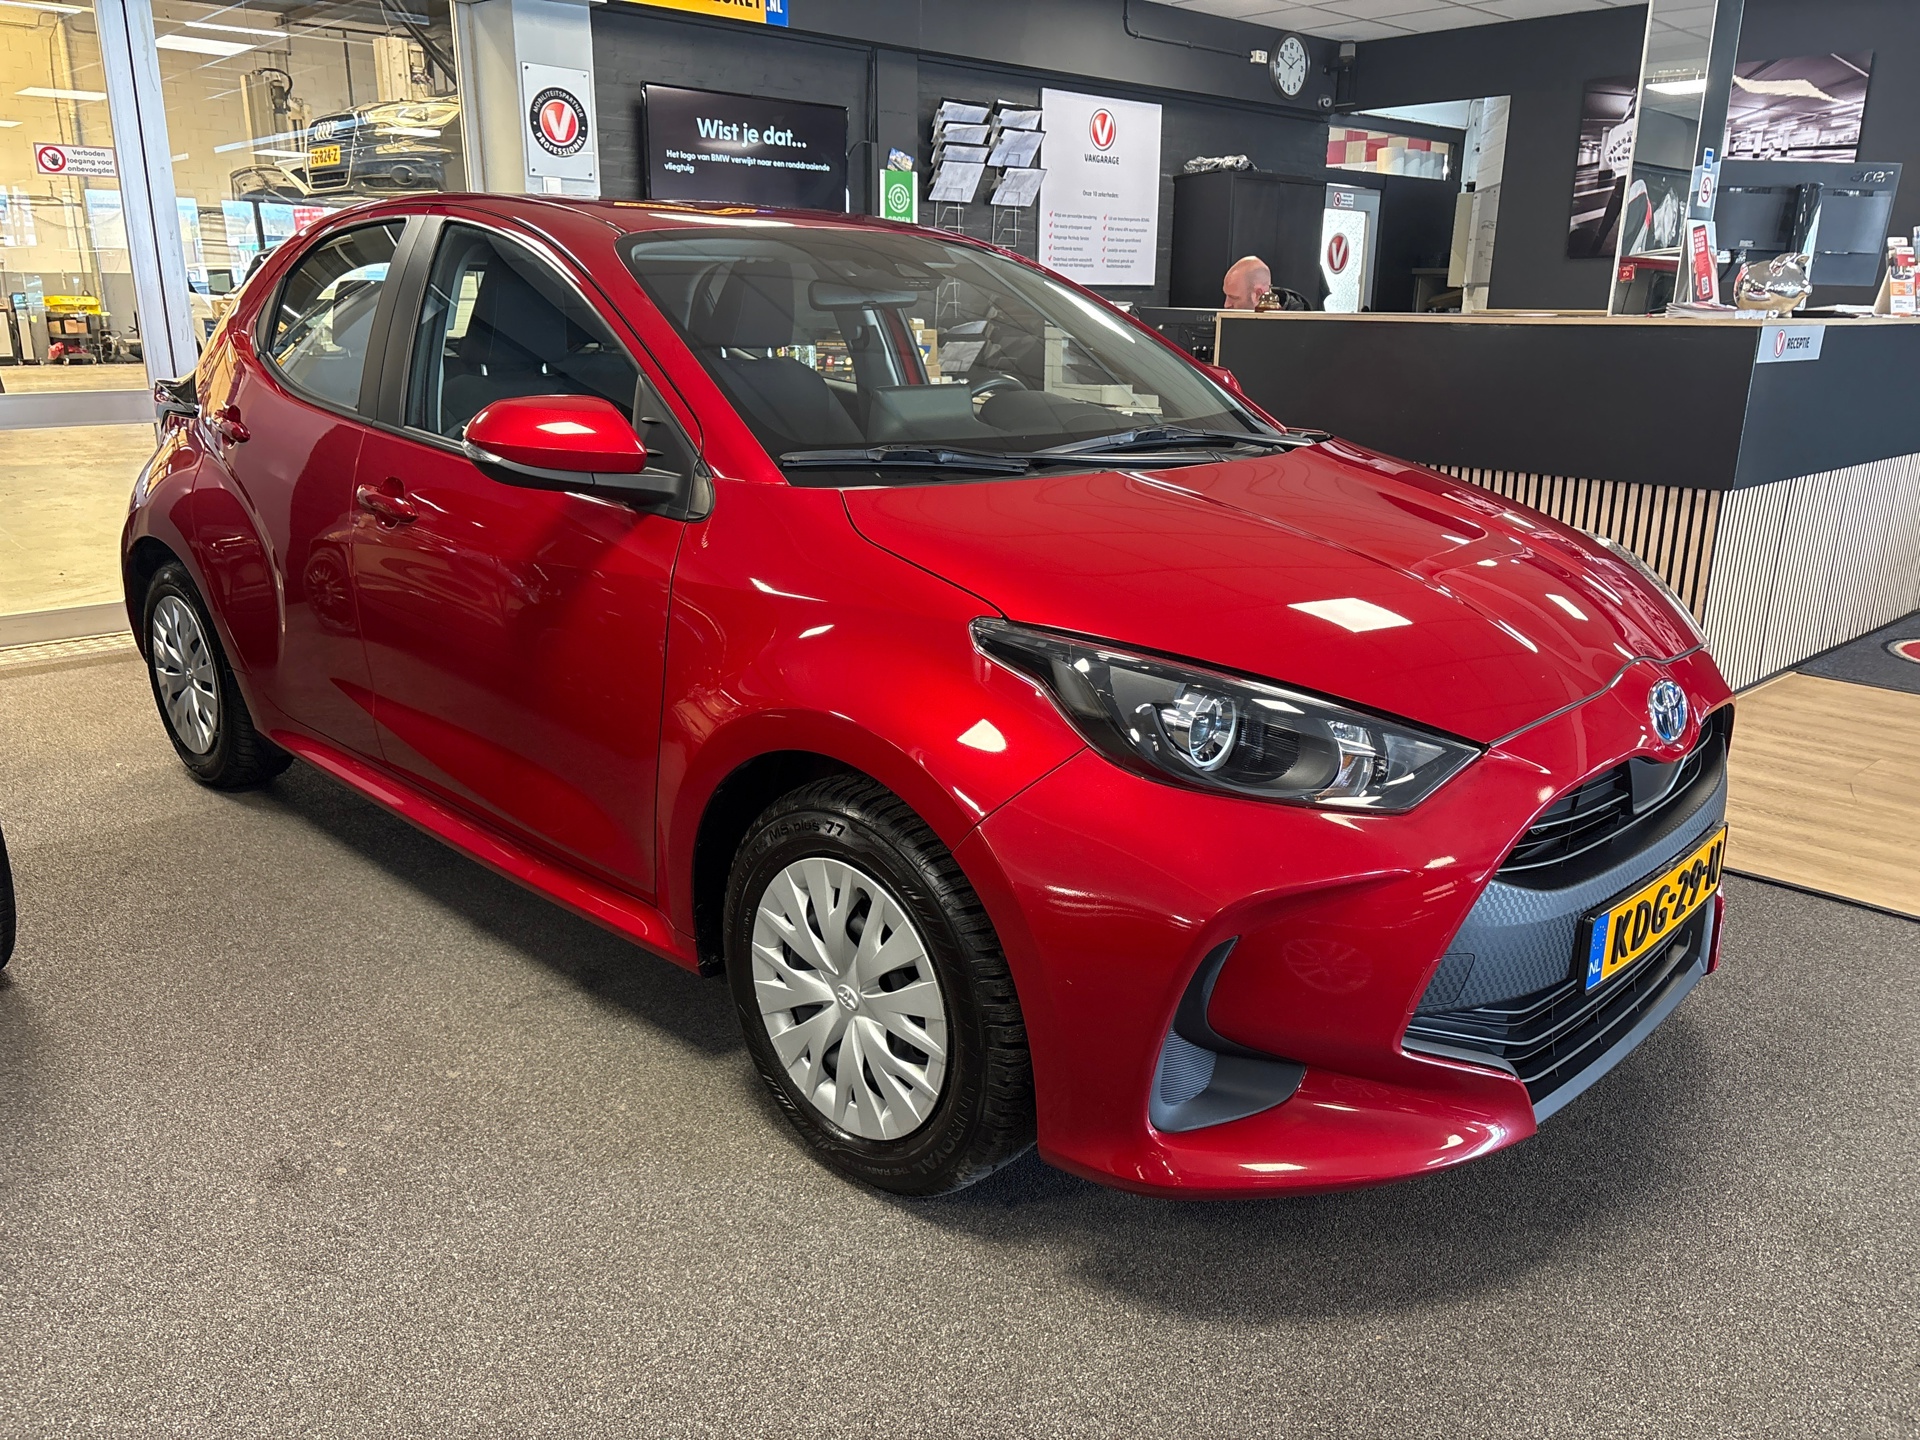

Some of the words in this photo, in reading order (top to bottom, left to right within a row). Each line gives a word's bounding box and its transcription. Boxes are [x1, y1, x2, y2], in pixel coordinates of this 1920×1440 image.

[533, 90, 584, 118] MOBILITEITSPARTNER
[696, 117, 739, 141] Wist
[742, 122, 759, 148] je
[763, 126, 807, 148] dat...
[536, 132, 585, 155] PROFESSIONAL
[72, 149, 105, 157] Verboden
[666, 150, 679, 158] Het
[680, 151, 696, 161] logo
[711, 154, 730, 163] BMW
[731, 156, 756, 167] verwijst
[757, 159, 772, 167] naar
[785, 160, 830, 172] ronddraaiende
[1084, 154, 1119, 165] VAKGARAGE
[67, 166, 114, 174] onbevoegden
[664, 162, 694, 173] vliegtuig
[1851, 170, 1894, 183] acer
[1787, 337, 1810, 349] RECEPTIE
[769, 823, 789, 842] MS
[793, 820, 820, 833] plus
[826, 821, 846, 836] 77
[1610, 840, 1723, 965] KDG-29-N
[1589, 959, 1601, 977] NL
